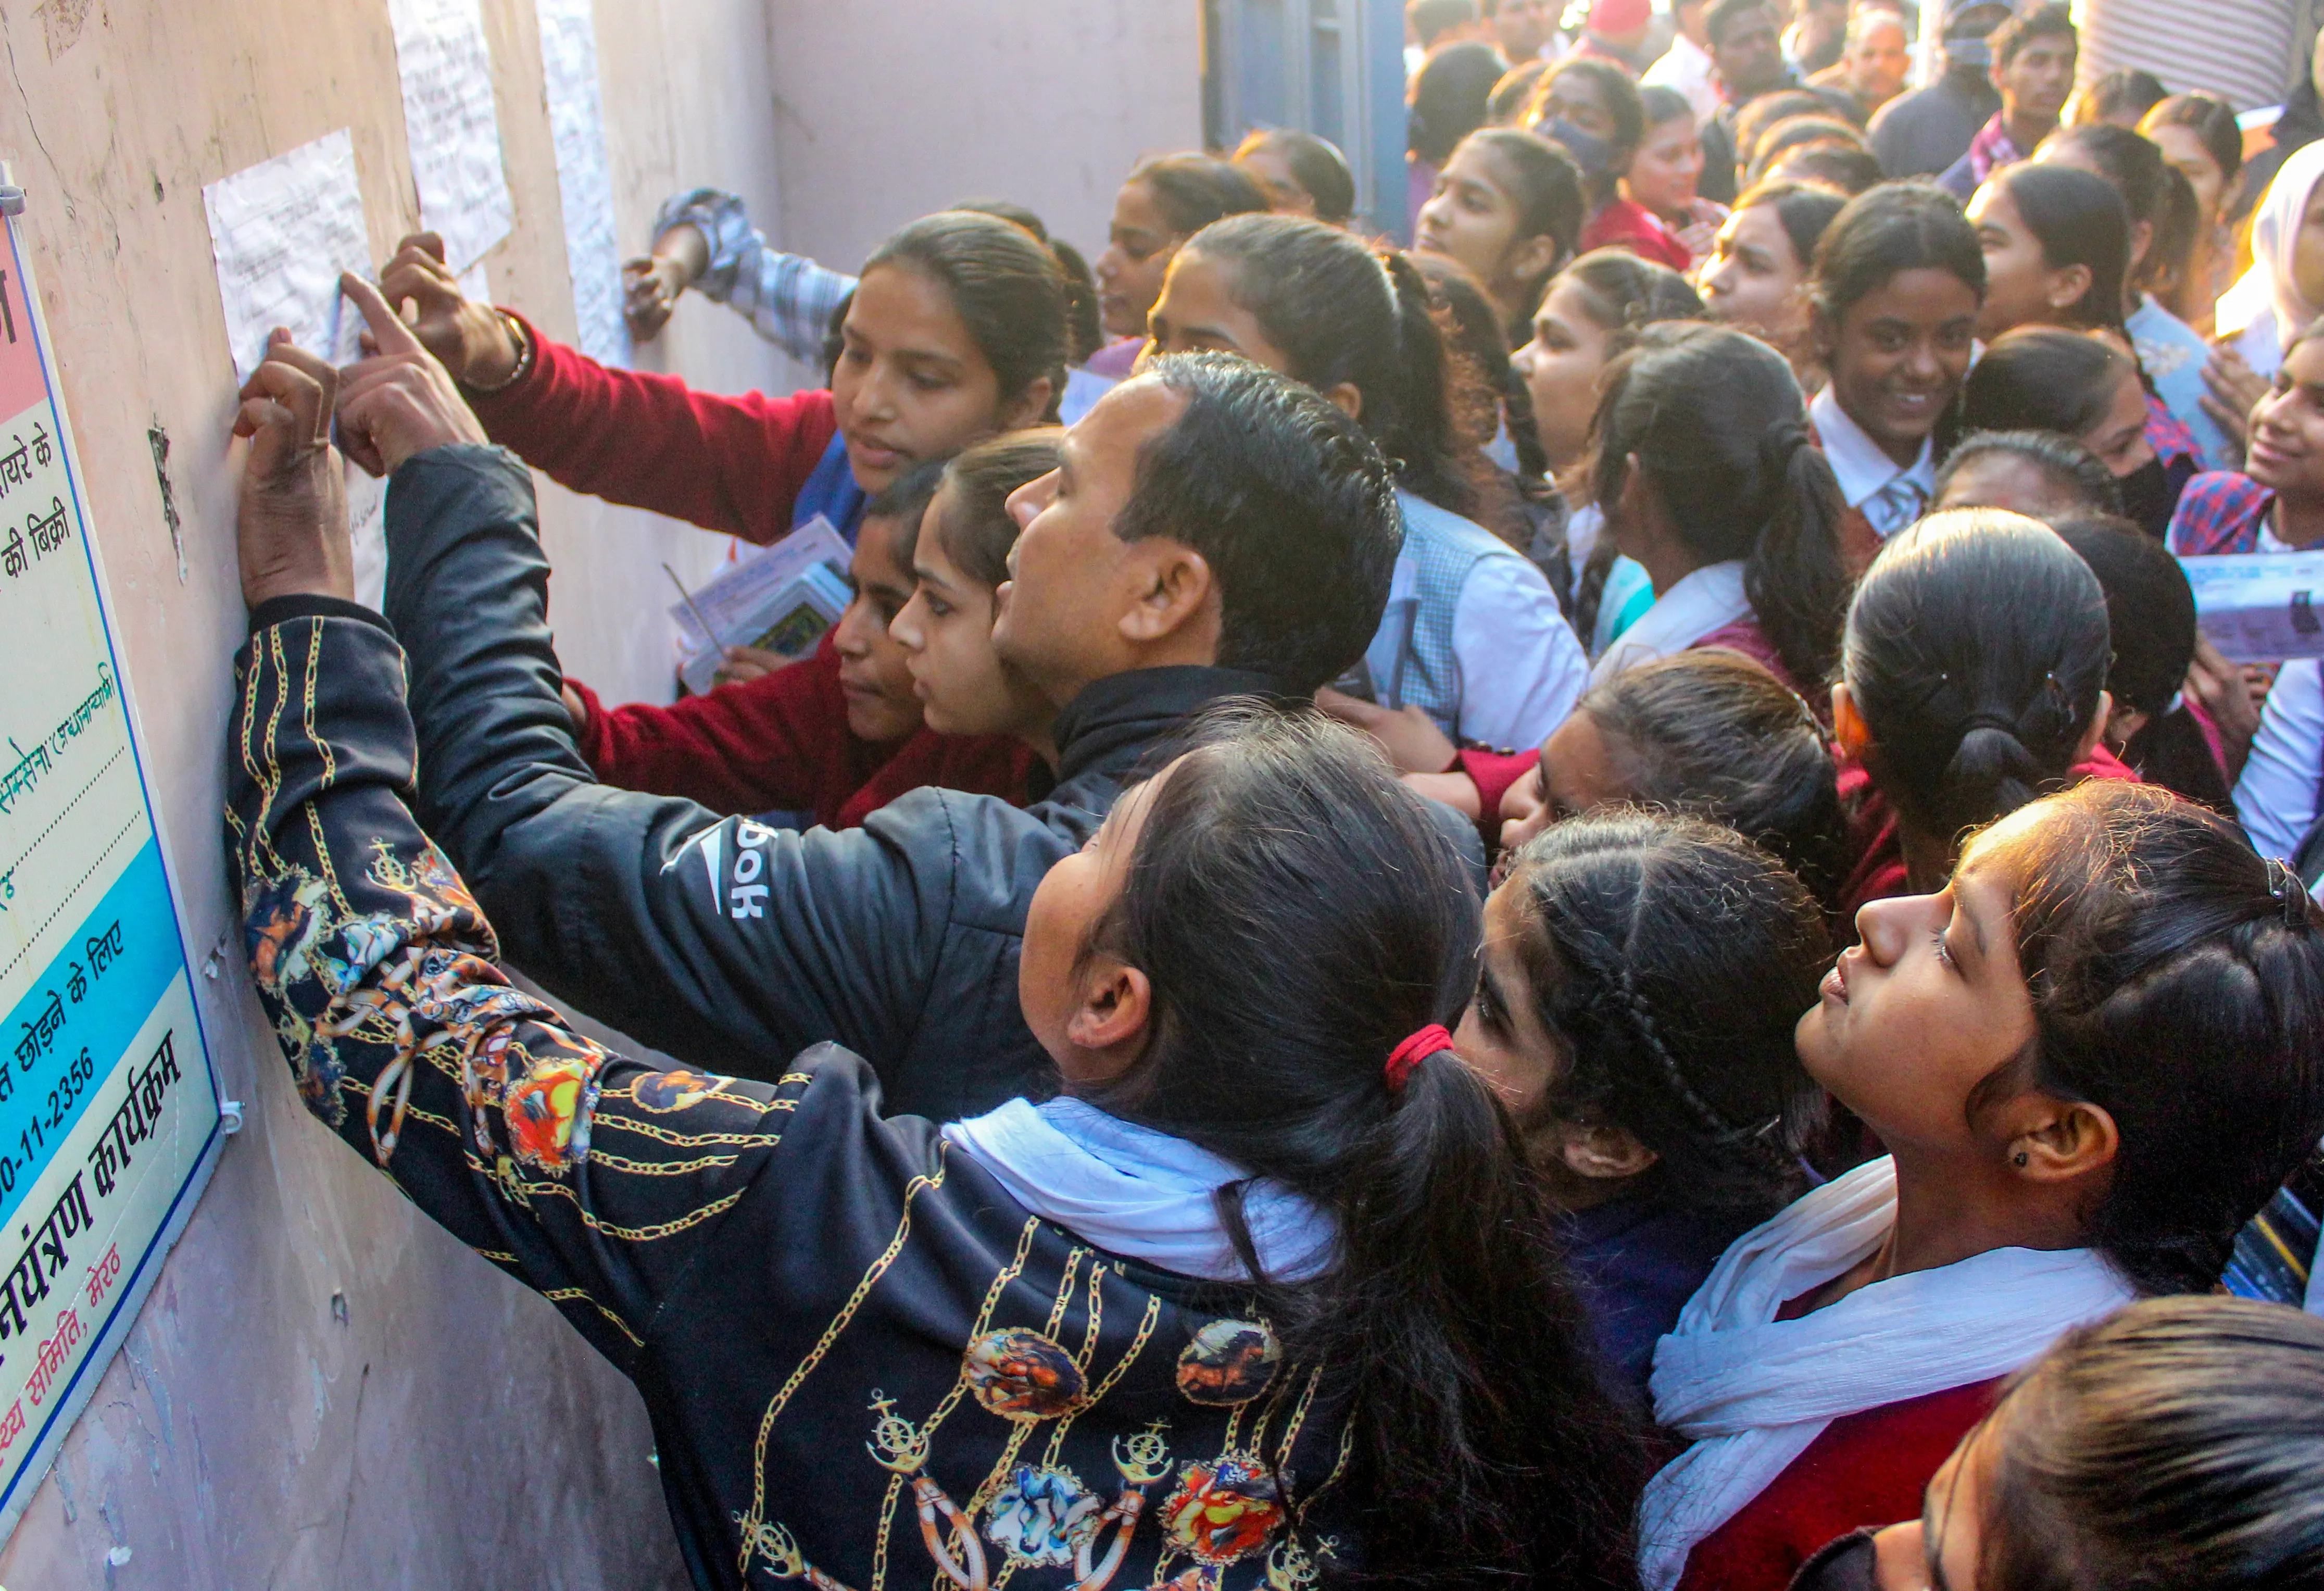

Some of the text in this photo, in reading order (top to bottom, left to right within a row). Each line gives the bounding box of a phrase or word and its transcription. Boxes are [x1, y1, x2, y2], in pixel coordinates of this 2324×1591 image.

[0, 422, 52, 499] ायरे के
[1, 496, 70, 578] की बिक्री
[731, 818, 779, 919] bok
[15, 989, 66, 1072] छोड़ने
[67, 961, 87, 1004] के
[86, 919, 124, 981] लिए
[0, 1047, 93, 1206] 0-11-2356
[88, 1030, 181, 1197] कार्यक्रम
[86, 1242, 120, 1307] मेरठ
